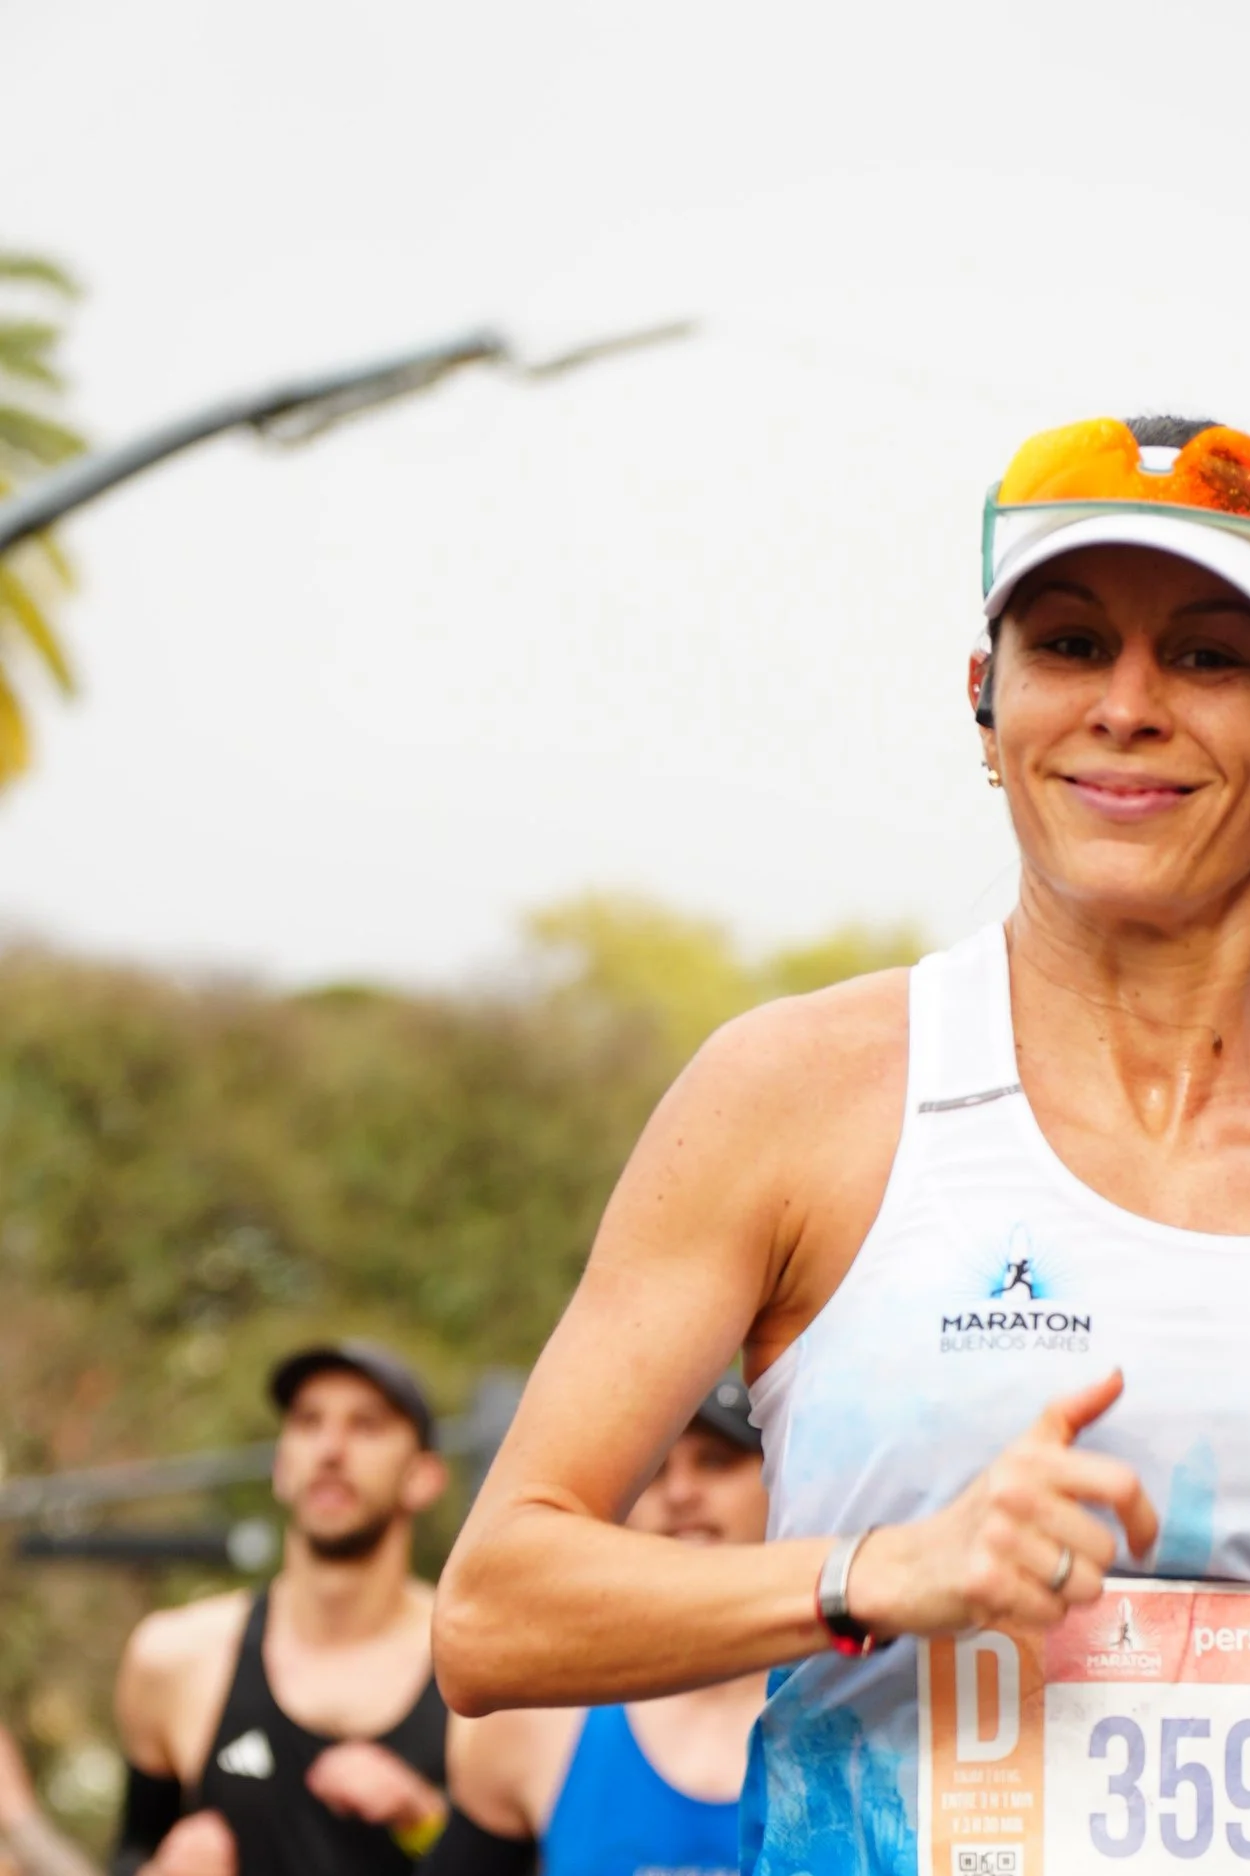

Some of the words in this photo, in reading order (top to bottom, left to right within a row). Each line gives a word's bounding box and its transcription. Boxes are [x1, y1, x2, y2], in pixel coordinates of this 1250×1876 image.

[941, 1312, 1091, 1332] MARATON
[941, 1335, 1026, 1353] BUENOS
[1033, 1335, 1090, 1352] AIRES
[1086, 1654, 1162, 1669] MARATON
[955, 1629, 1020, 1762] D
